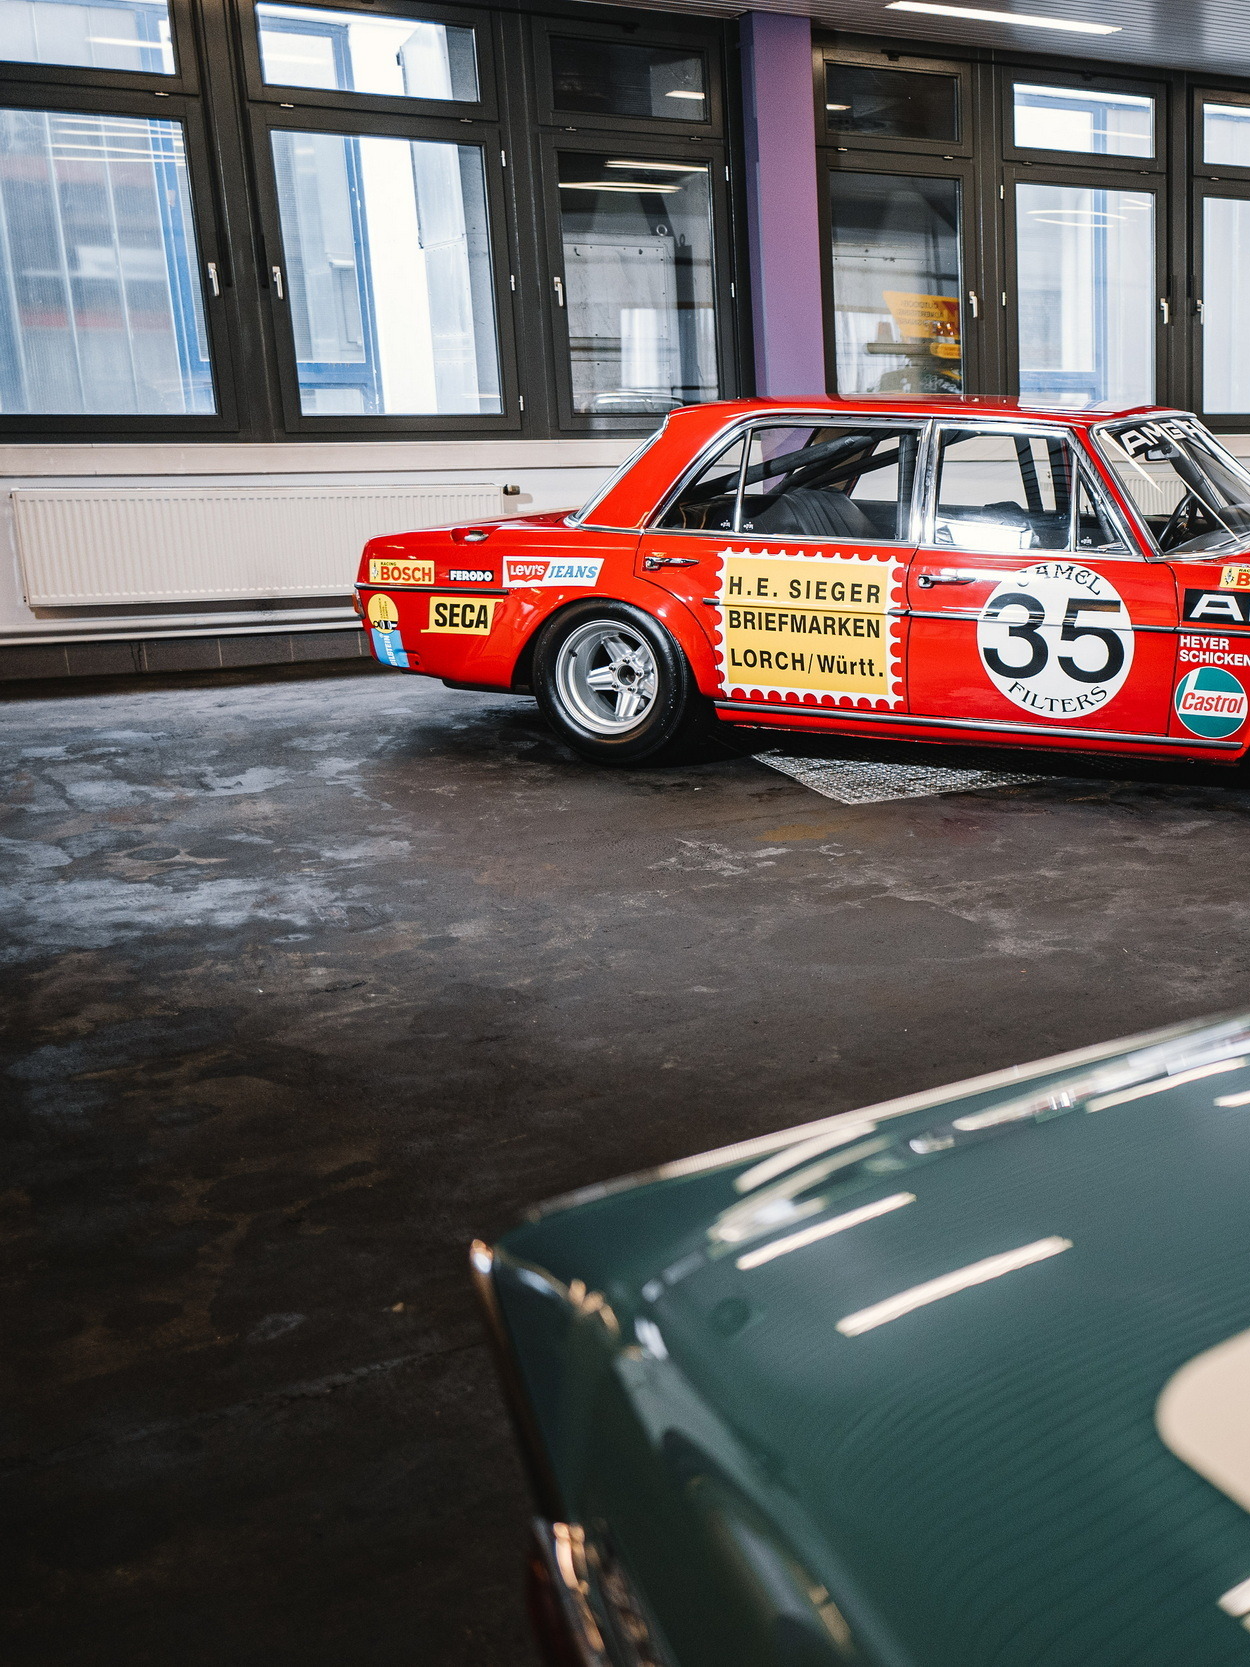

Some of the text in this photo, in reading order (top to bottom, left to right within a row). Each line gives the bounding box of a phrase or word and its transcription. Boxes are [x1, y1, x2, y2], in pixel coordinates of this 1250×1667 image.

[381, 566, 432, 582] BOSCH
[450, 570, 493, 582] FERODO
[548, 565, 598, 579] JEANS
[789, 579, 881, 604] SIEGER
[434, 602, 488, 630] SECA
[729, 610, 881, 639] BRIEFMARKEN
[983, 592, 1125, 684] 35
[1180, 636, 1230, 651] HEYER
[1008, 681, 1108, 713] FILTERS
[1181, 692, 1244, 714] Castrol
